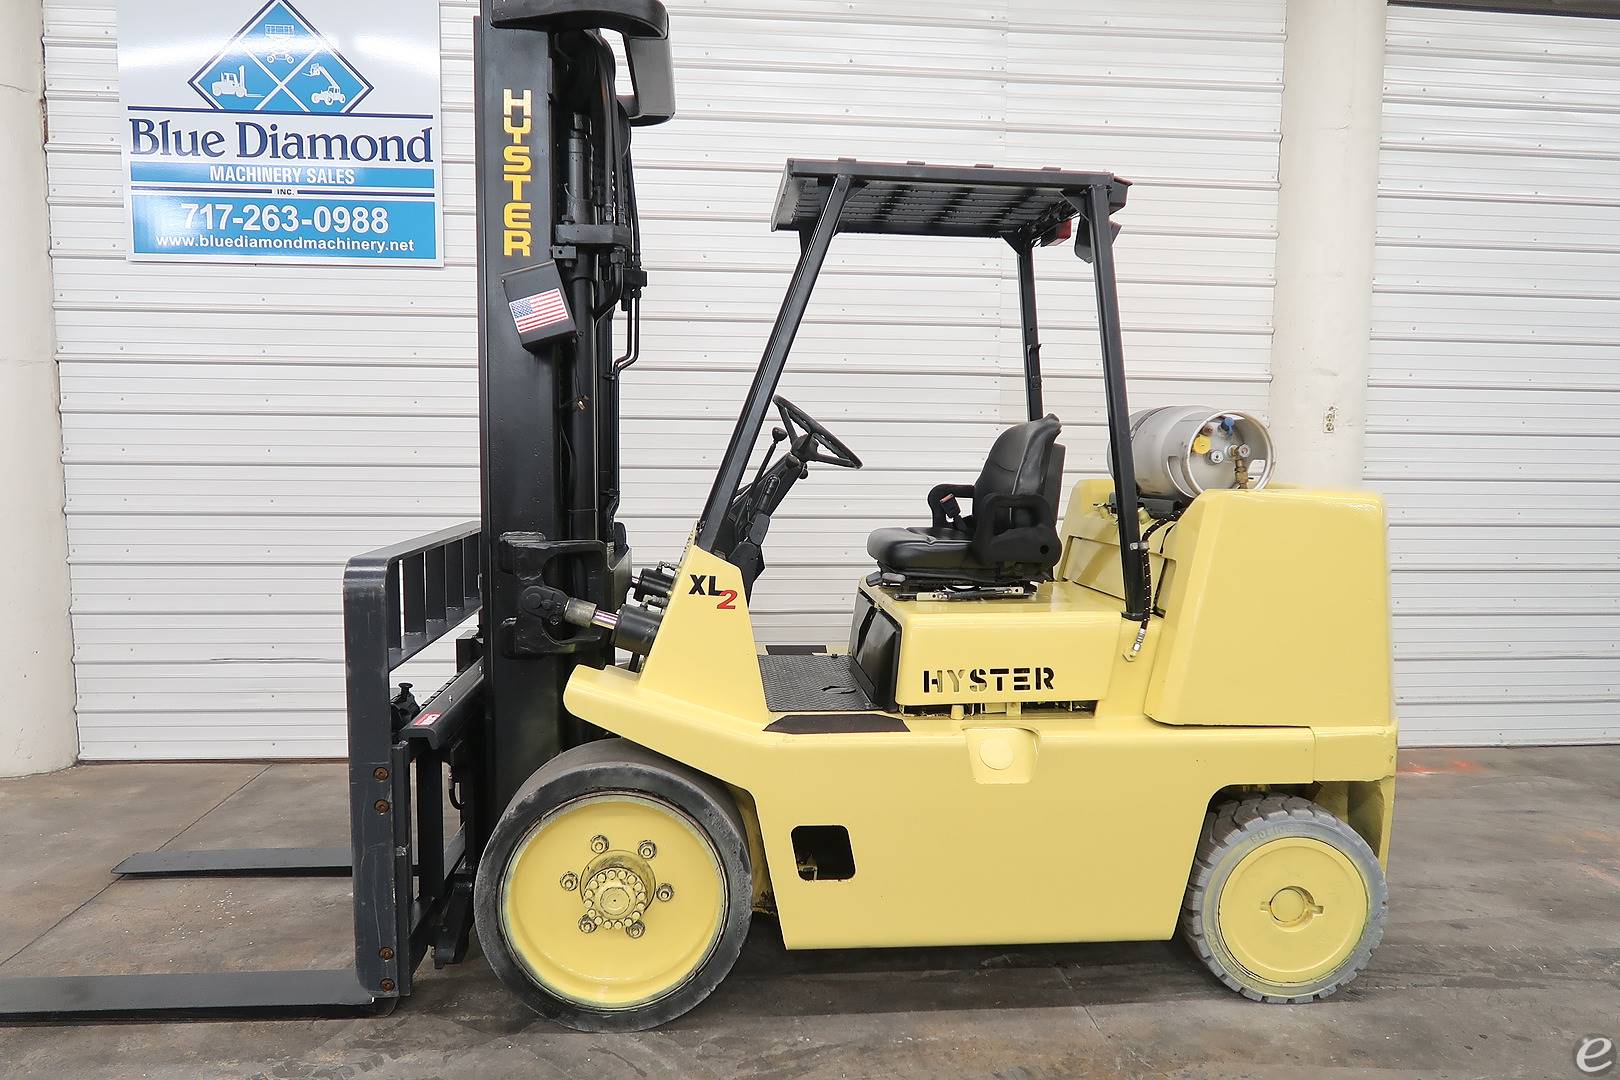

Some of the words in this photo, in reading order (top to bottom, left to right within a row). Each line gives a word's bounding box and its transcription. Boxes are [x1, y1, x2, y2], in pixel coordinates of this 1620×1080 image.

[128, 117, 226, 158] Blue
[235, 120, 434, 164] Diamond
[209, 165, 302, 184] MACHINERY
[306, 167, 355, 185] SALES
[503, 88, 532, 257] HYSTER
[276, 188, 295, 196] INC.
[181, 203, 390, 235] 717-263-0988
[155, 234, 415, 254] www.bluediamondmachinery.net
[923, 667, 1055, 694] HYSTER
